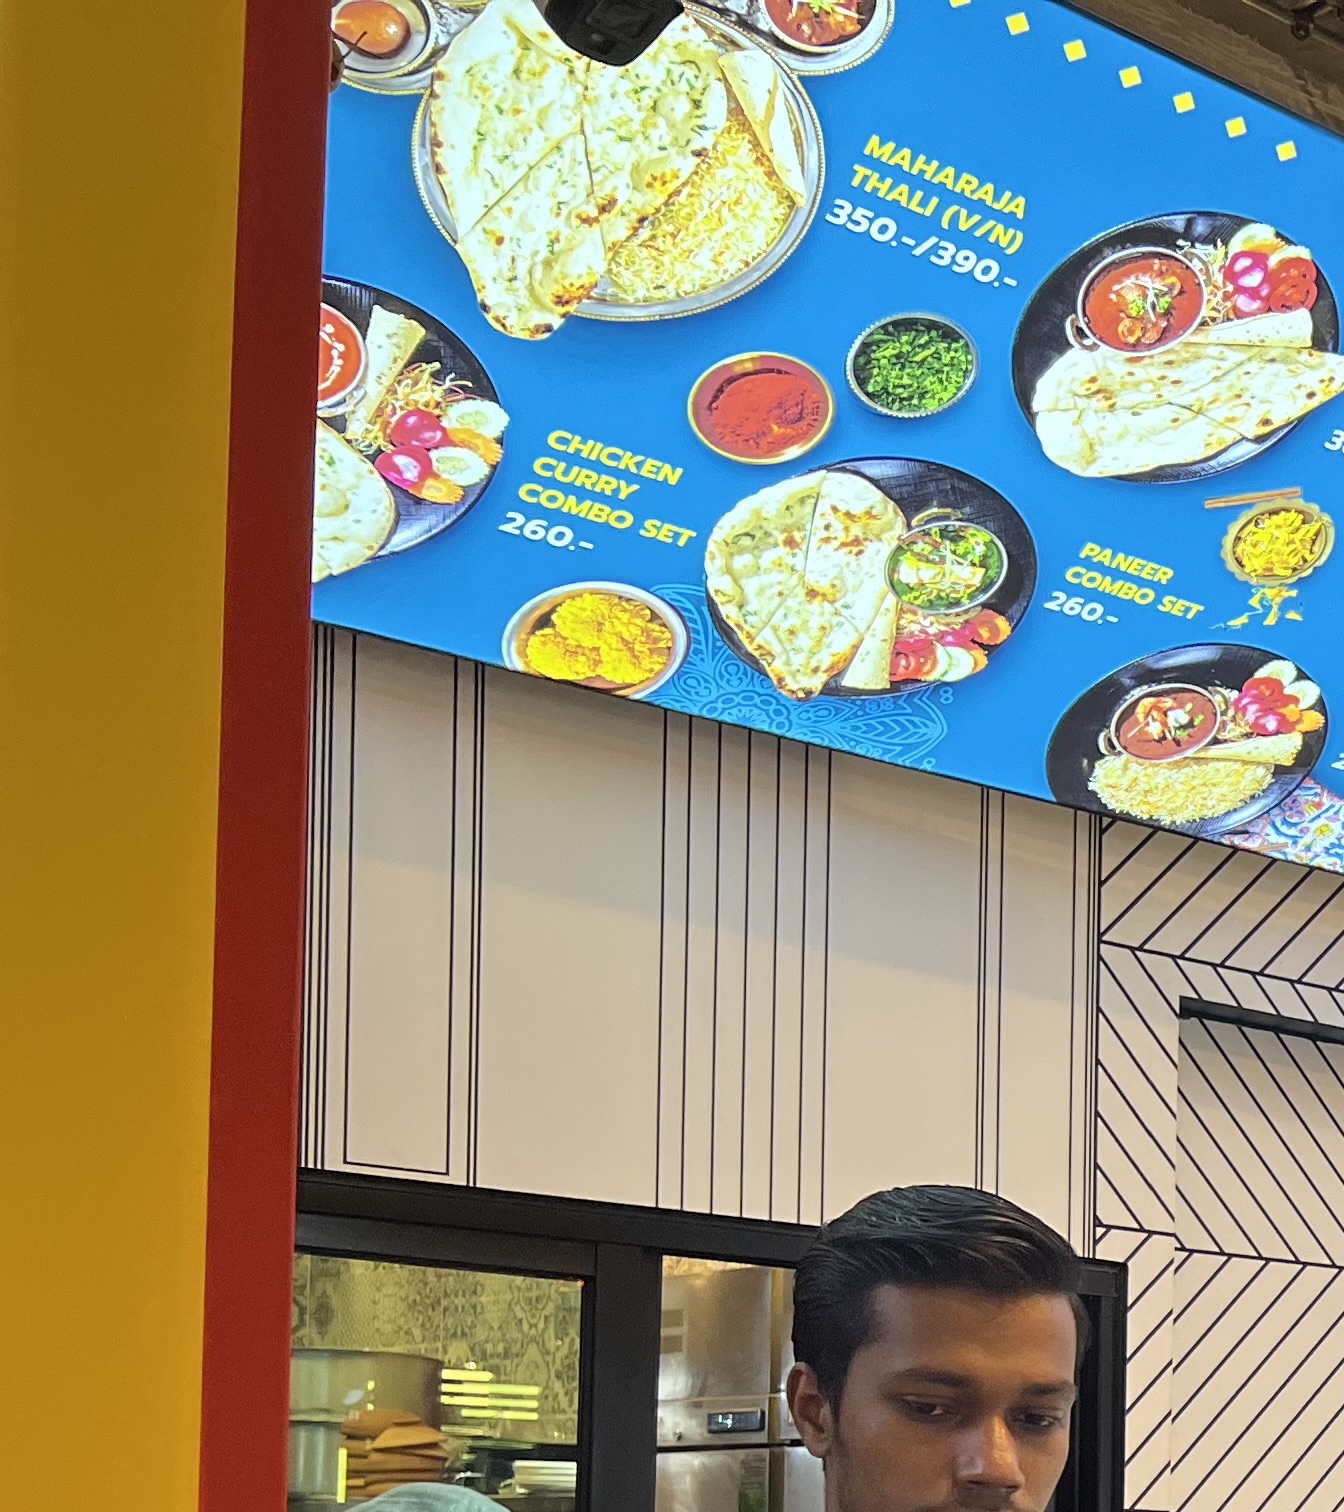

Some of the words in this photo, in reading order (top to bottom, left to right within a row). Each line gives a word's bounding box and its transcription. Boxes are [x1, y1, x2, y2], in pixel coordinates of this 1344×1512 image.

[864, 133, 1026, 219] MAHARAJA
[851, 164, 938, 226] THALI
[942, 203, 1024, 255] (V/N)
[533, 456, 640, 500] CURRY
[548, 430, 683, 486] CHICKEN
[499, 512, 593, 551] 260.-
[519, 483, 633, 530] COMBO
[640, 519, 697, 548] SET
[1080, 542, 1174, 585] PANEER
[1044, 591, 1119, 625] 260.-
[1065, 566, 1152, 605] COMBO
[1154, 594, 1205, 620] SET
